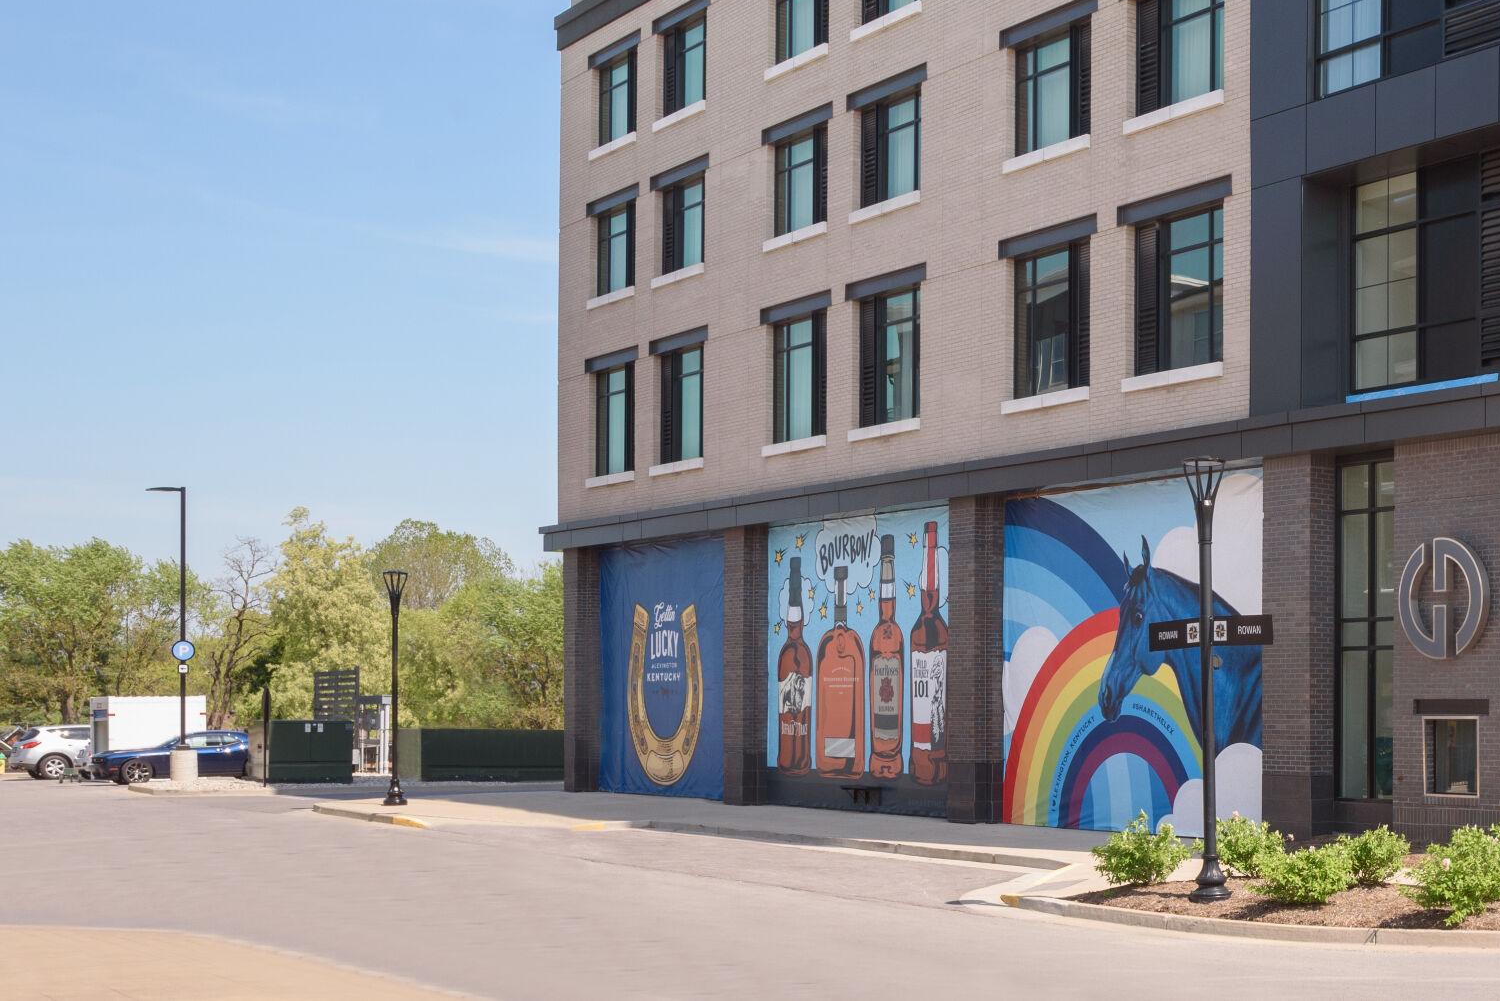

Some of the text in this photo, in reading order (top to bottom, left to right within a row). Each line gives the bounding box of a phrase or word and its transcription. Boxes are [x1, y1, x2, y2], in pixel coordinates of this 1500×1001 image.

[819, 529, 874, 575] BOURBON!
[1158, 630, 1178, 640] ROWAN
[1237, 625, 1262, 635] ROWAN
[178, 645, 190, 657] P
[650, 630, 679, 659] LUCKY
[646, 672, 681, 682] KENTUCKY
[914, 680, 929, 698] 101
[1132, 703, 1175, 735] #SHARETHELEX
[1070, 716, 1096, 748] KENTUCKY
